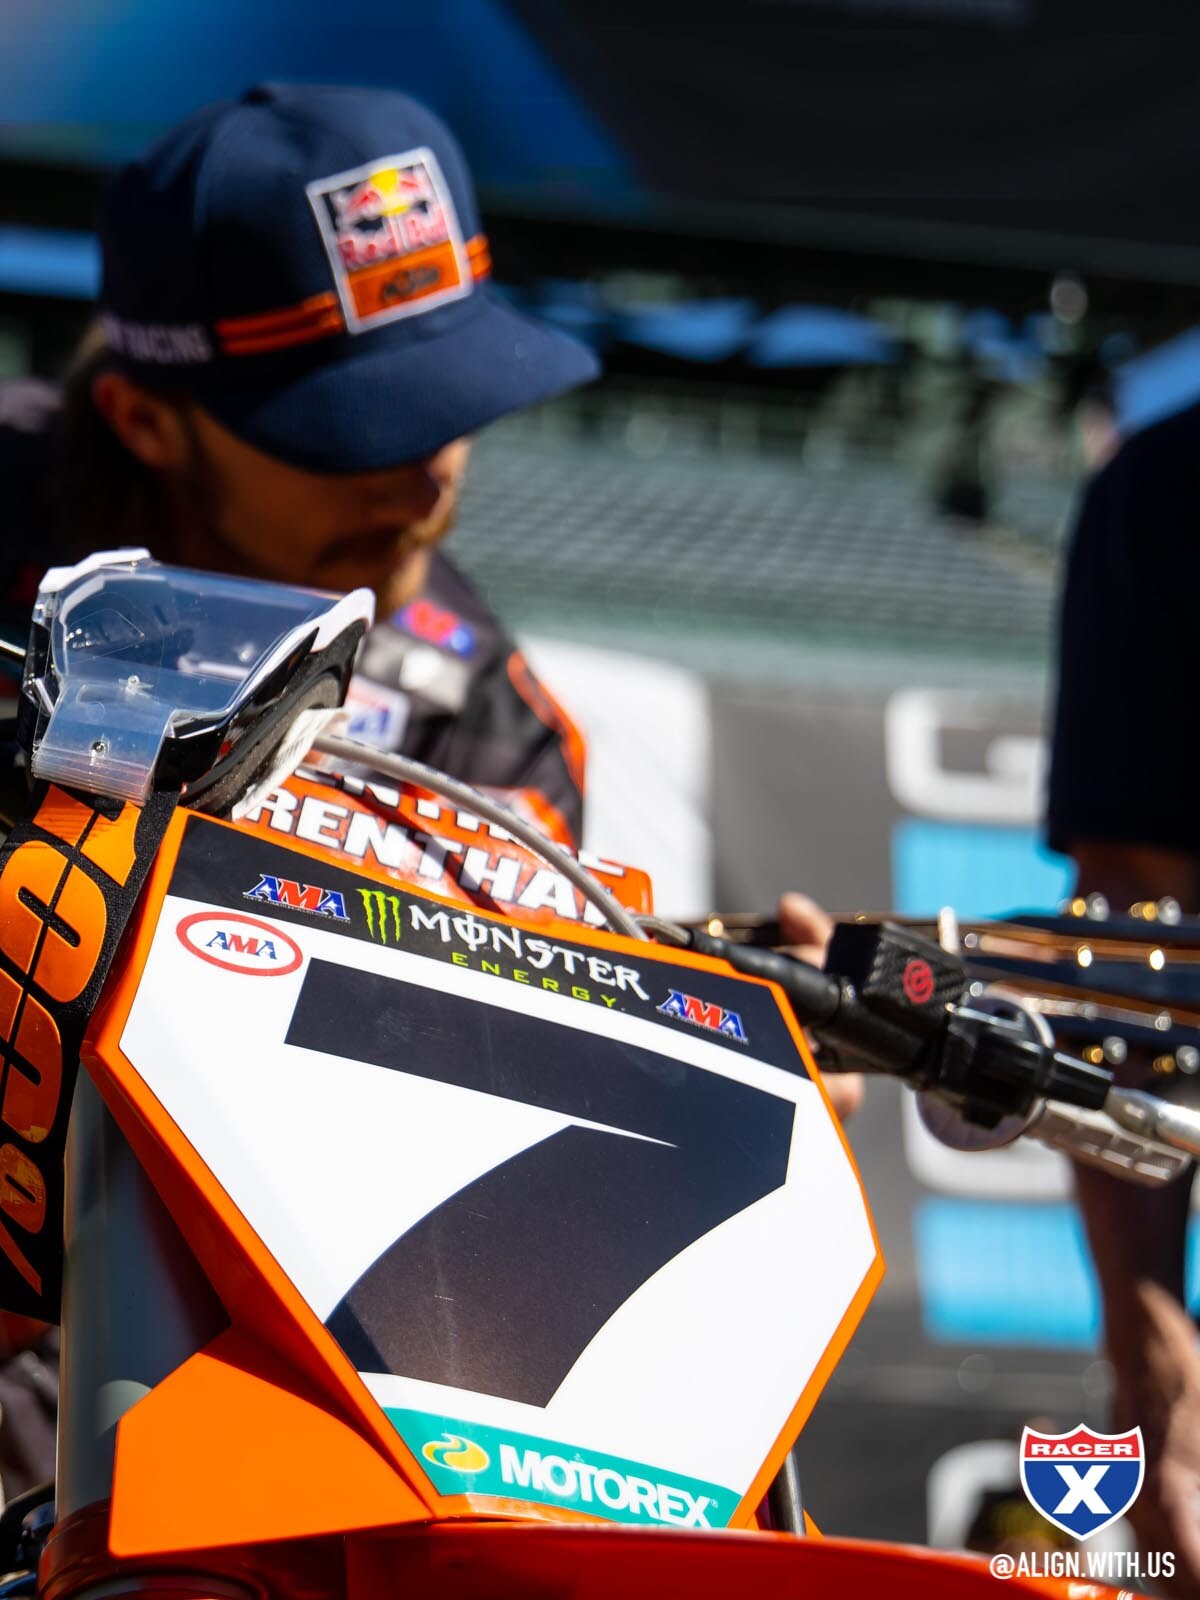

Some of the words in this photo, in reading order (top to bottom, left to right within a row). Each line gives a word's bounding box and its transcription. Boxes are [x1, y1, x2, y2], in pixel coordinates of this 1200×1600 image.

[242, 873, 350, 919] AMA
[205, 930, 277, 960] AMA
[451, 951, 617, 1009] ENERGY
[655, 988, 749, 1043] AMA
[284, 957, 797, 1410] 7
[499, 1443, 713, 1530] MOTOREX
